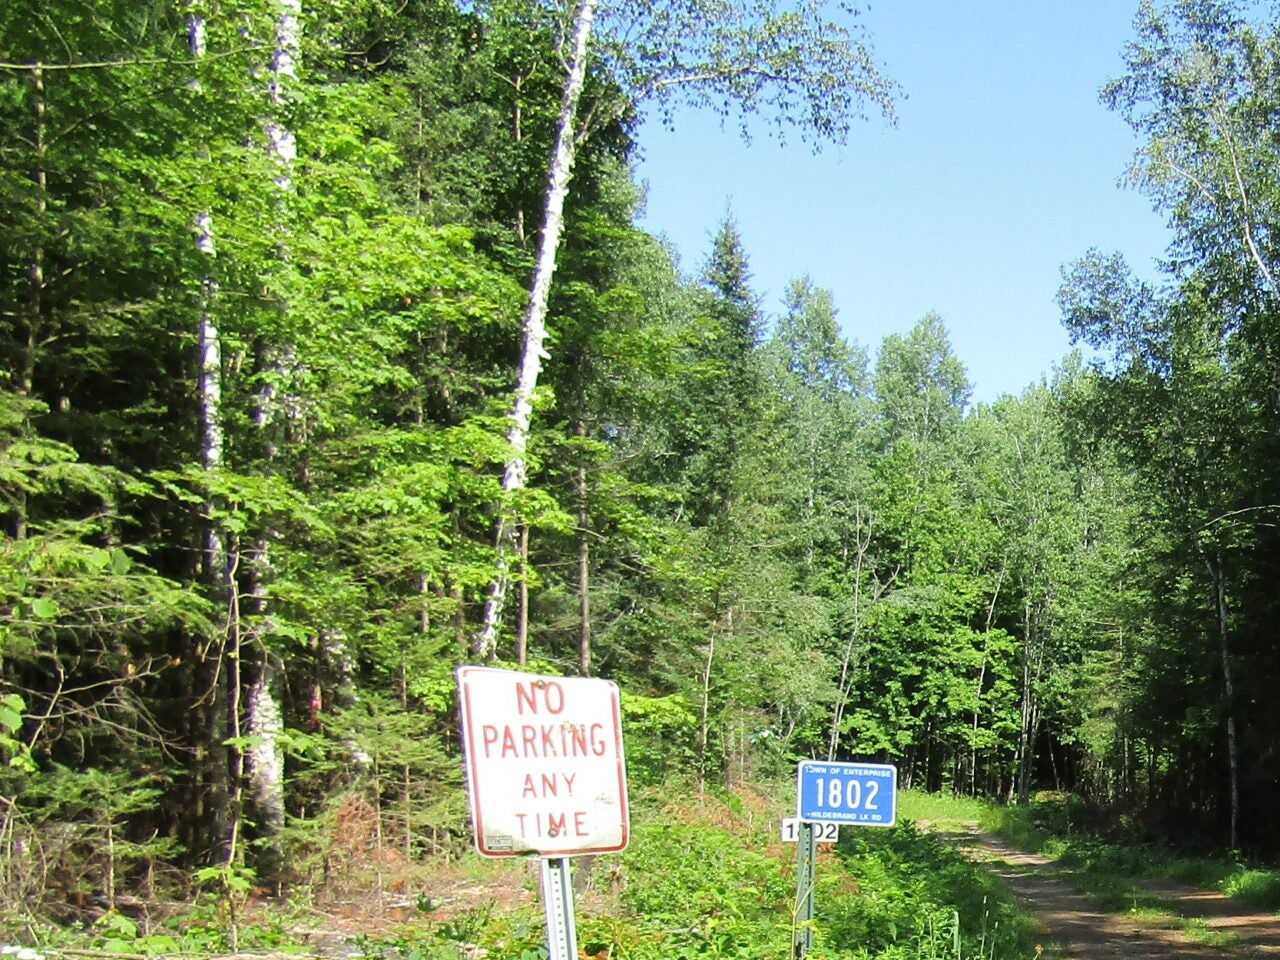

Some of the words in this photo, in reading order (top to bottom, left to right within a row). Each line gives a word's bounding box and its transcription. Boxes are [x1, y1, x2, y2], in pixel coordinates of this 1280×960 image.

[516, 681, 565, 715] NO
[482, 723, 606, 759] PARKING
[805, 765, 827, 774] TOWN
[830, 767, 840, 775] OF
[844, 768, 892, 778] ENTERPRISE
[522, 772, 577, 798] ANY
[816, 778, 879, 810] 1802
[515, 811, 589, 838] TIME
[811, 811, 857, 820] HILDEBRAND
[786, 823, 837, 839] 102
